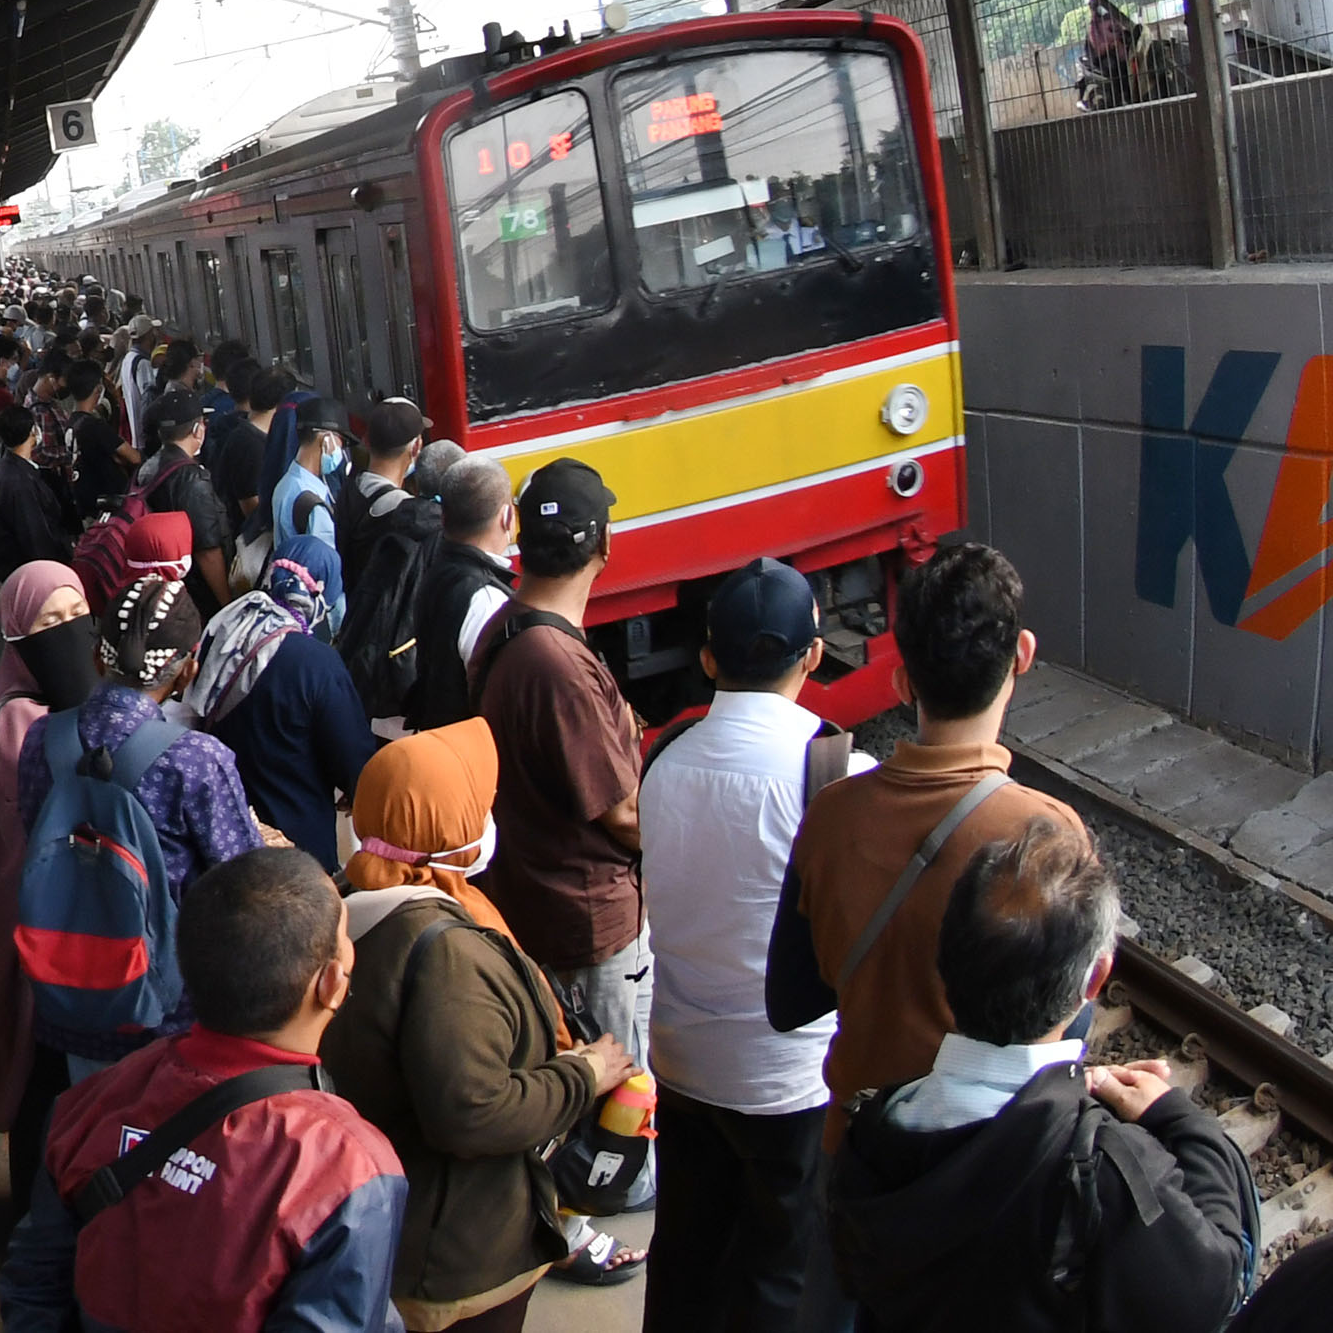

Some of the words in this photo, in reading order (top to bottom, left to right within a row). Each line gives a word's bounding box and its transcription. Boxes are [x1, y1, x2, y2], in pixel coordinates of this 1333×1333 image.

[650, 91, 717, 122] PARUNG
[62, 110, 84, 141] 6
[647, 111, 724, 144] PANJANG
[504, 209, 540, 233] 78
